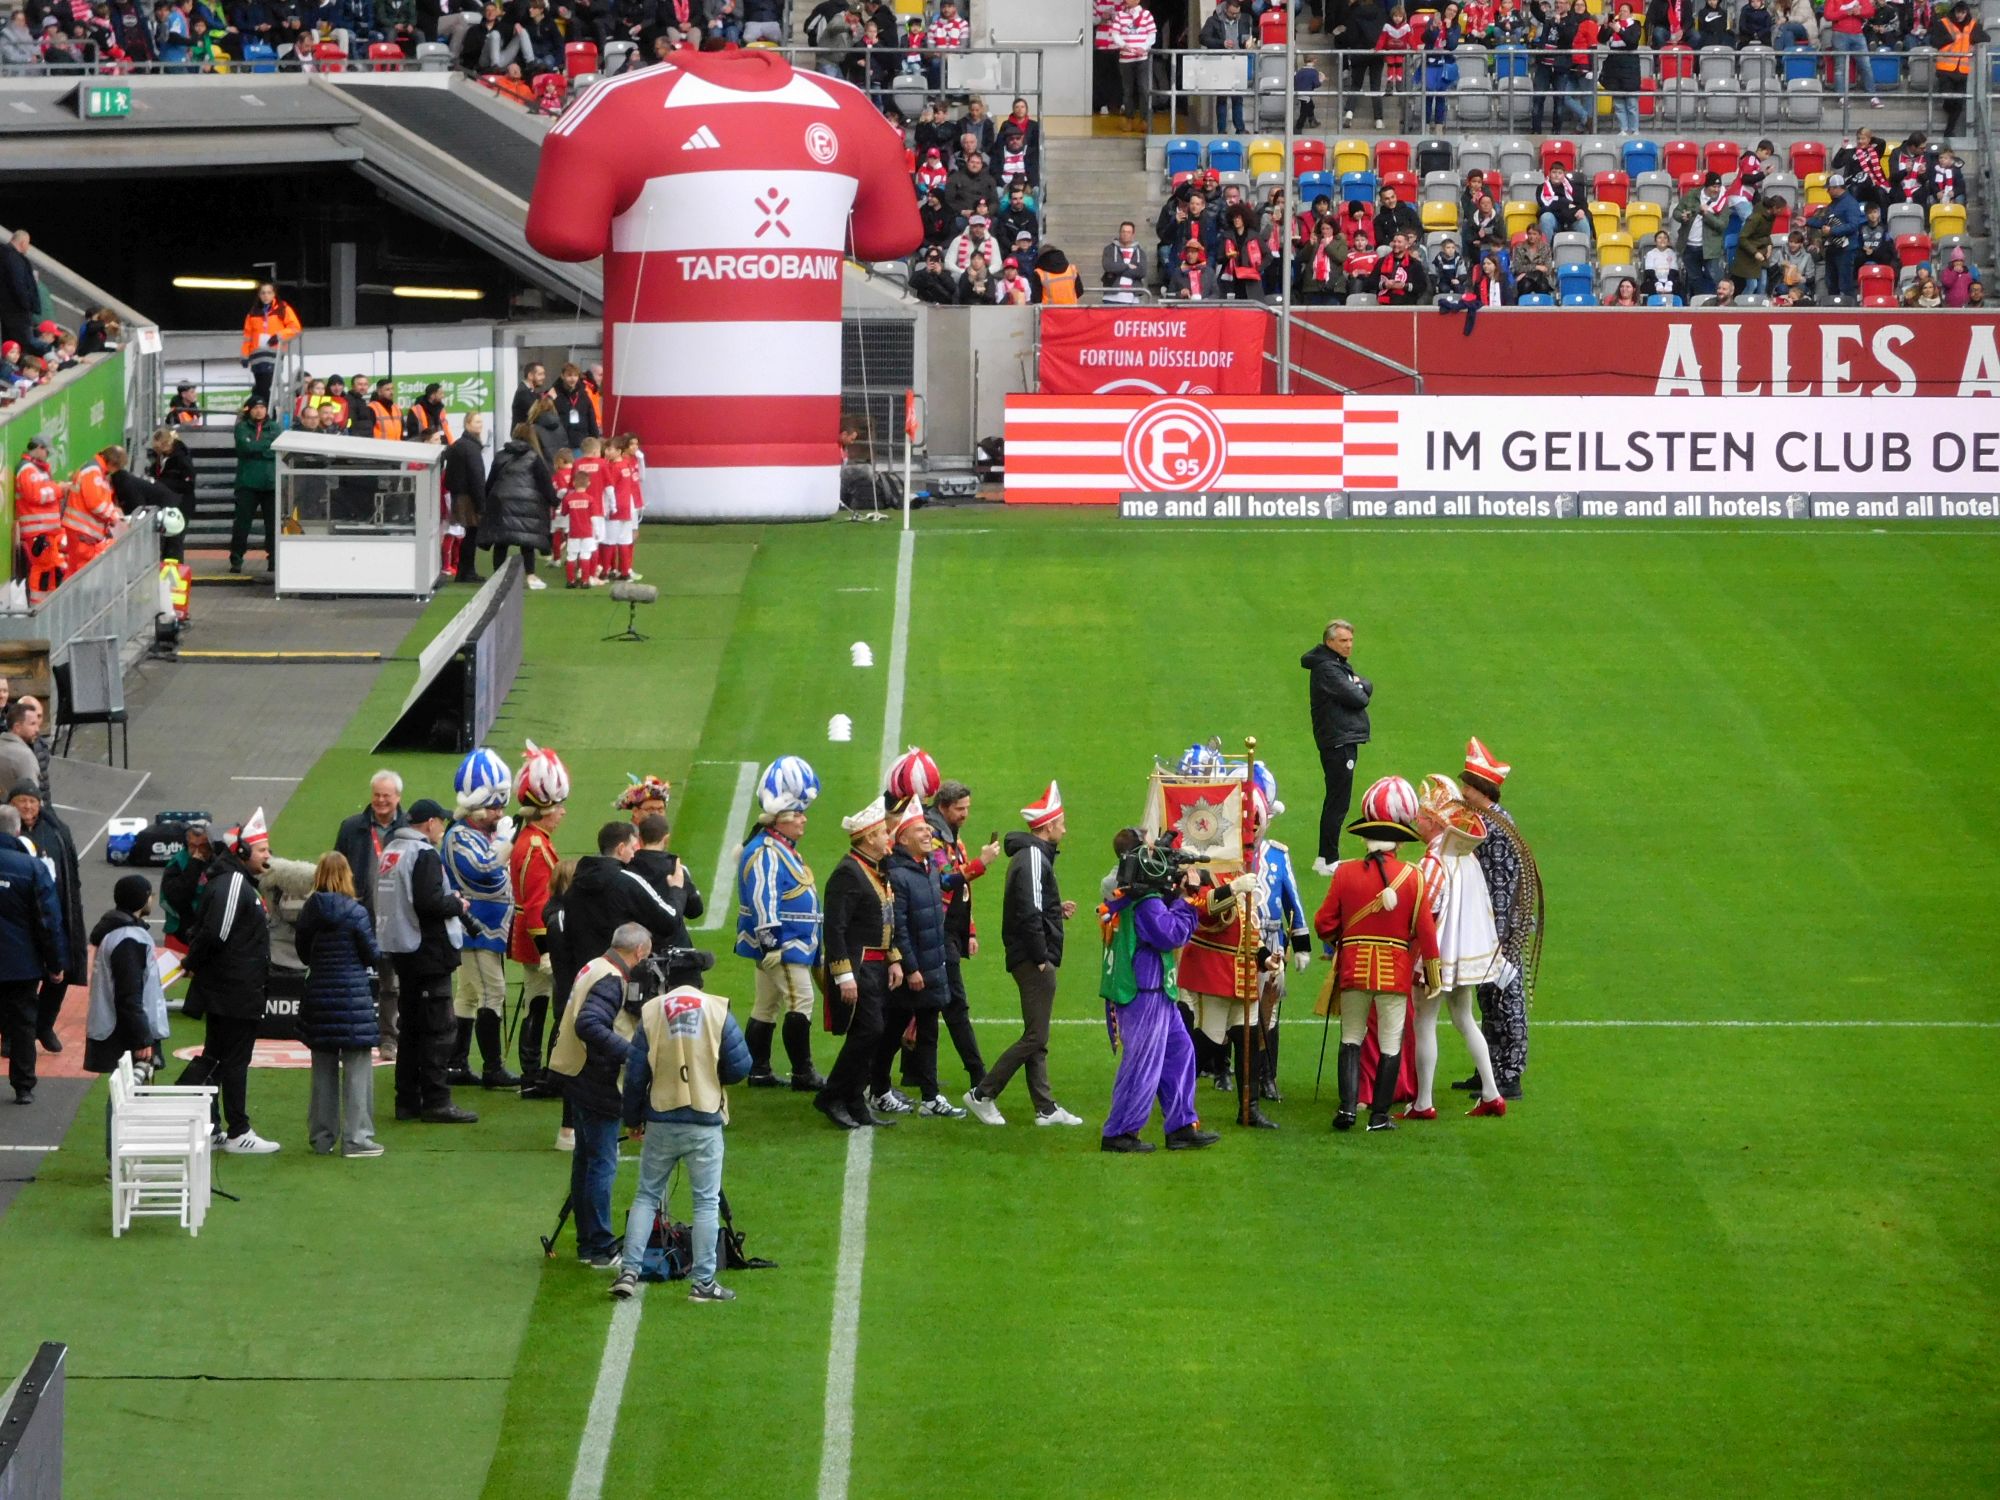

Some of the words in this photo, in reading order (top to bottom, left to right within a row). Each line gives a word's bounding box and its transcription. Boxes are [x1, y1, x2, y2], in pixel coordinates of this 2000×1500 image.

[676, 254, 839, 281] TARGOBANK
[1113, 320, 1187, 338] OFFENSIVE
[1079, 349, 1144, 367] FORTUNA
[1148, 347, 1235, 368] DÜSSELDORF
[1654, 323, 1918, 396] ALLES
[1426, 431, 1481, 471] IM
[1502, 430, 1754, 472] GEILSTEN
[1775, 431, 1912, 473] CLUB
[1932, 431, 1999, 473] DE
[1174, 458, 1200, 476] 95
[1122, 500, 1159, 516] me
[1164, 495, 1207, 516] and
[1213, 495, 1241, 516] all
[1247, 495, 1321, 516] hotels
[1352, 500, 1388, 516] me
[1393, 495, 1437, 516] and
[1443, 495, 1472, 516] all
[1477, 495, 1551, 516] hotels
[1582, 500, 1619, 516] me
[1624, 495, 1667, 516] and
[1673, 495, 1702, 516] all
[1708, 495, 1782, 516] hotels
[1813, 500, 1850, 516] me
[1856, 495, 1899, 516] and
[1905, 495, 1934, 516] all
